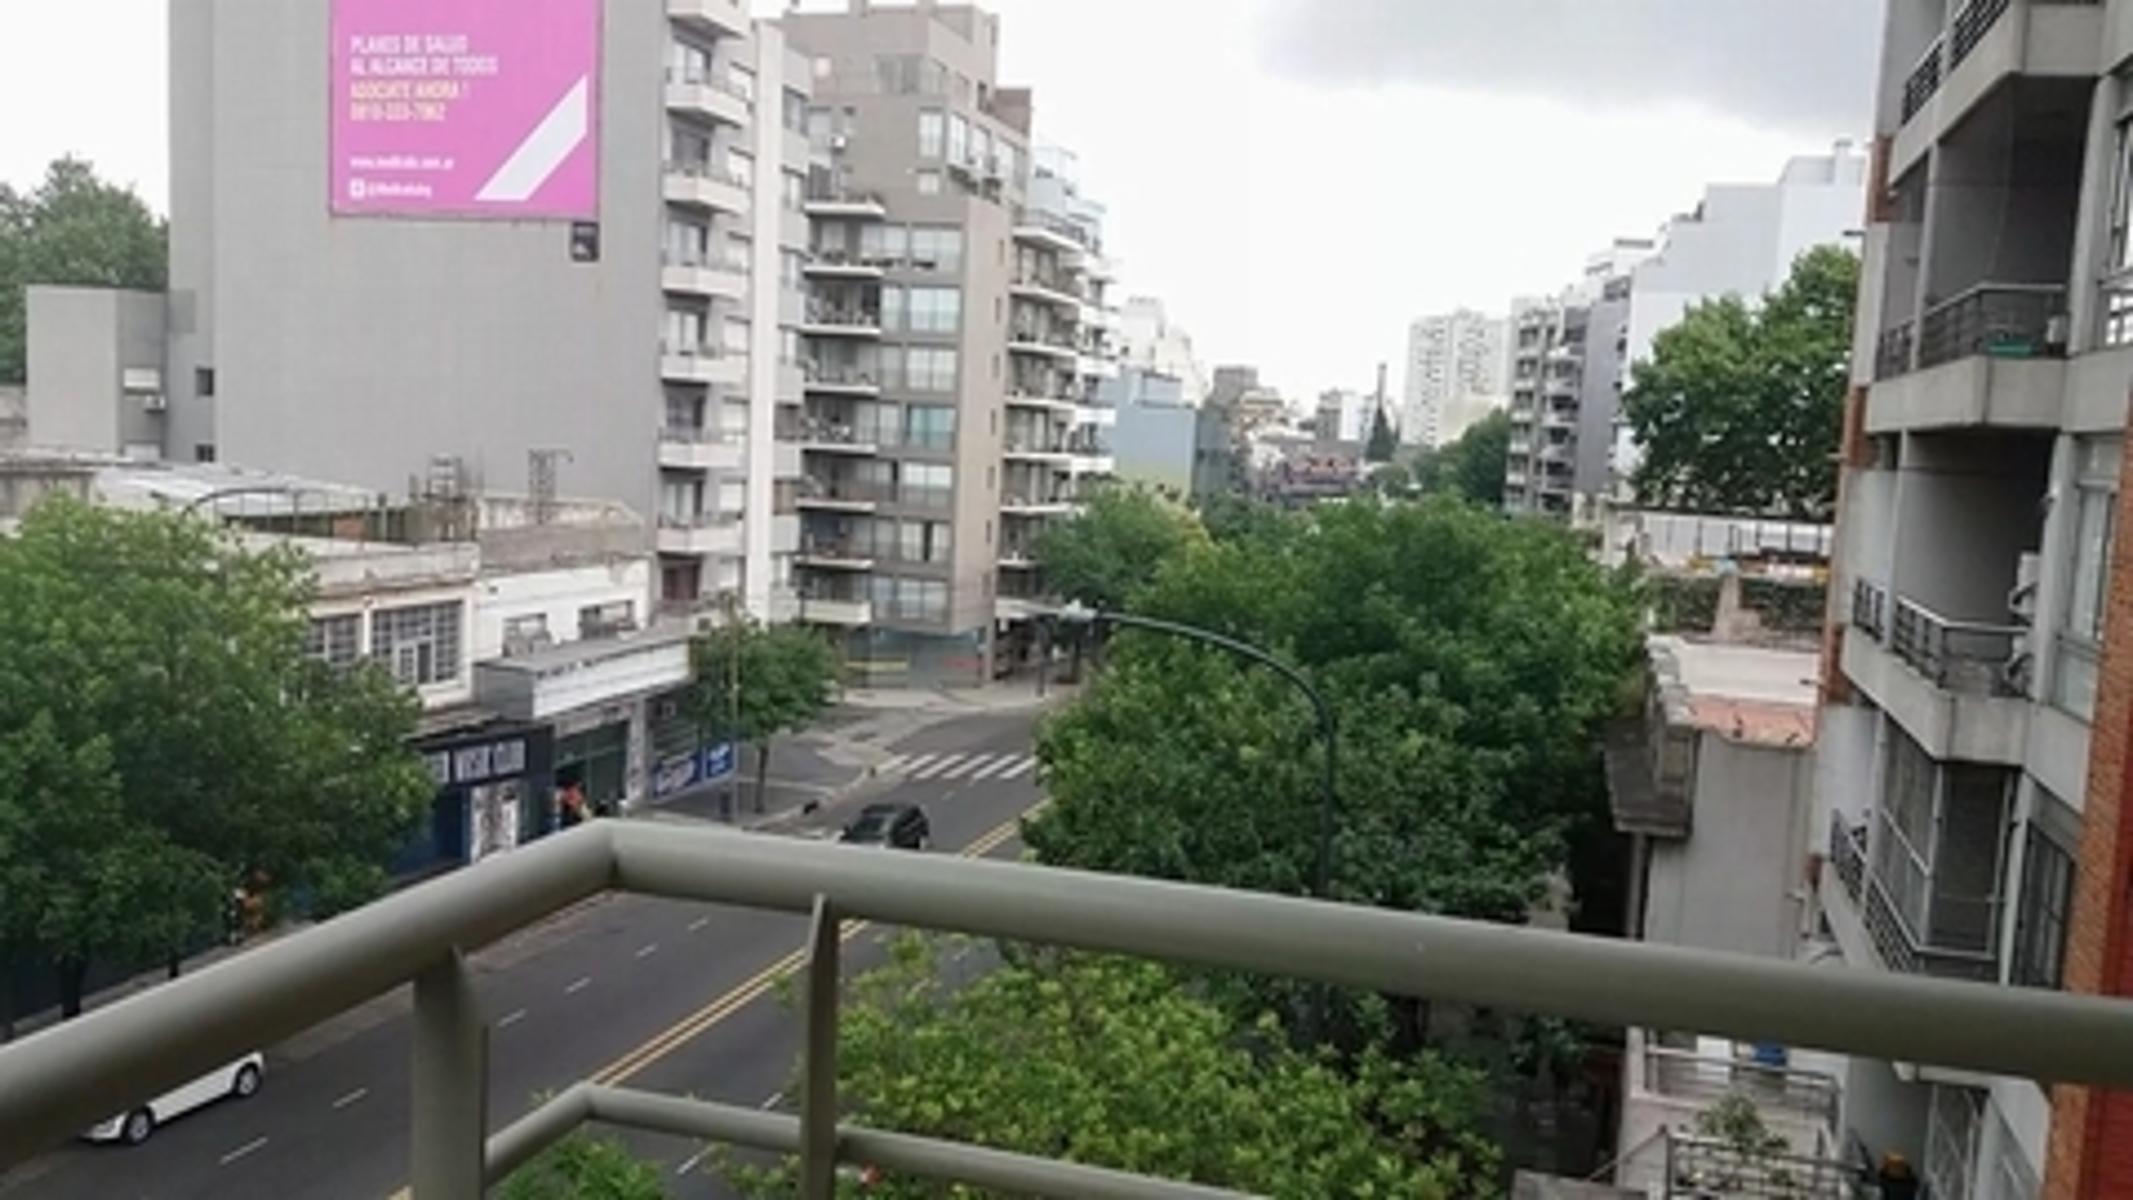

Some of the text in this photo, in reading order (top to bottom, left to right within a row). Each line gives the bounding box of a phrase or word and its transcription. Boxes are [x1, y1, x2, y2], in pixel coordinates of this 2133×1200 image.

[350, 36, 467, 54] PLANES DE SALUD
[350, 57, 498, 76] AL ALCANCE DE TODOS
